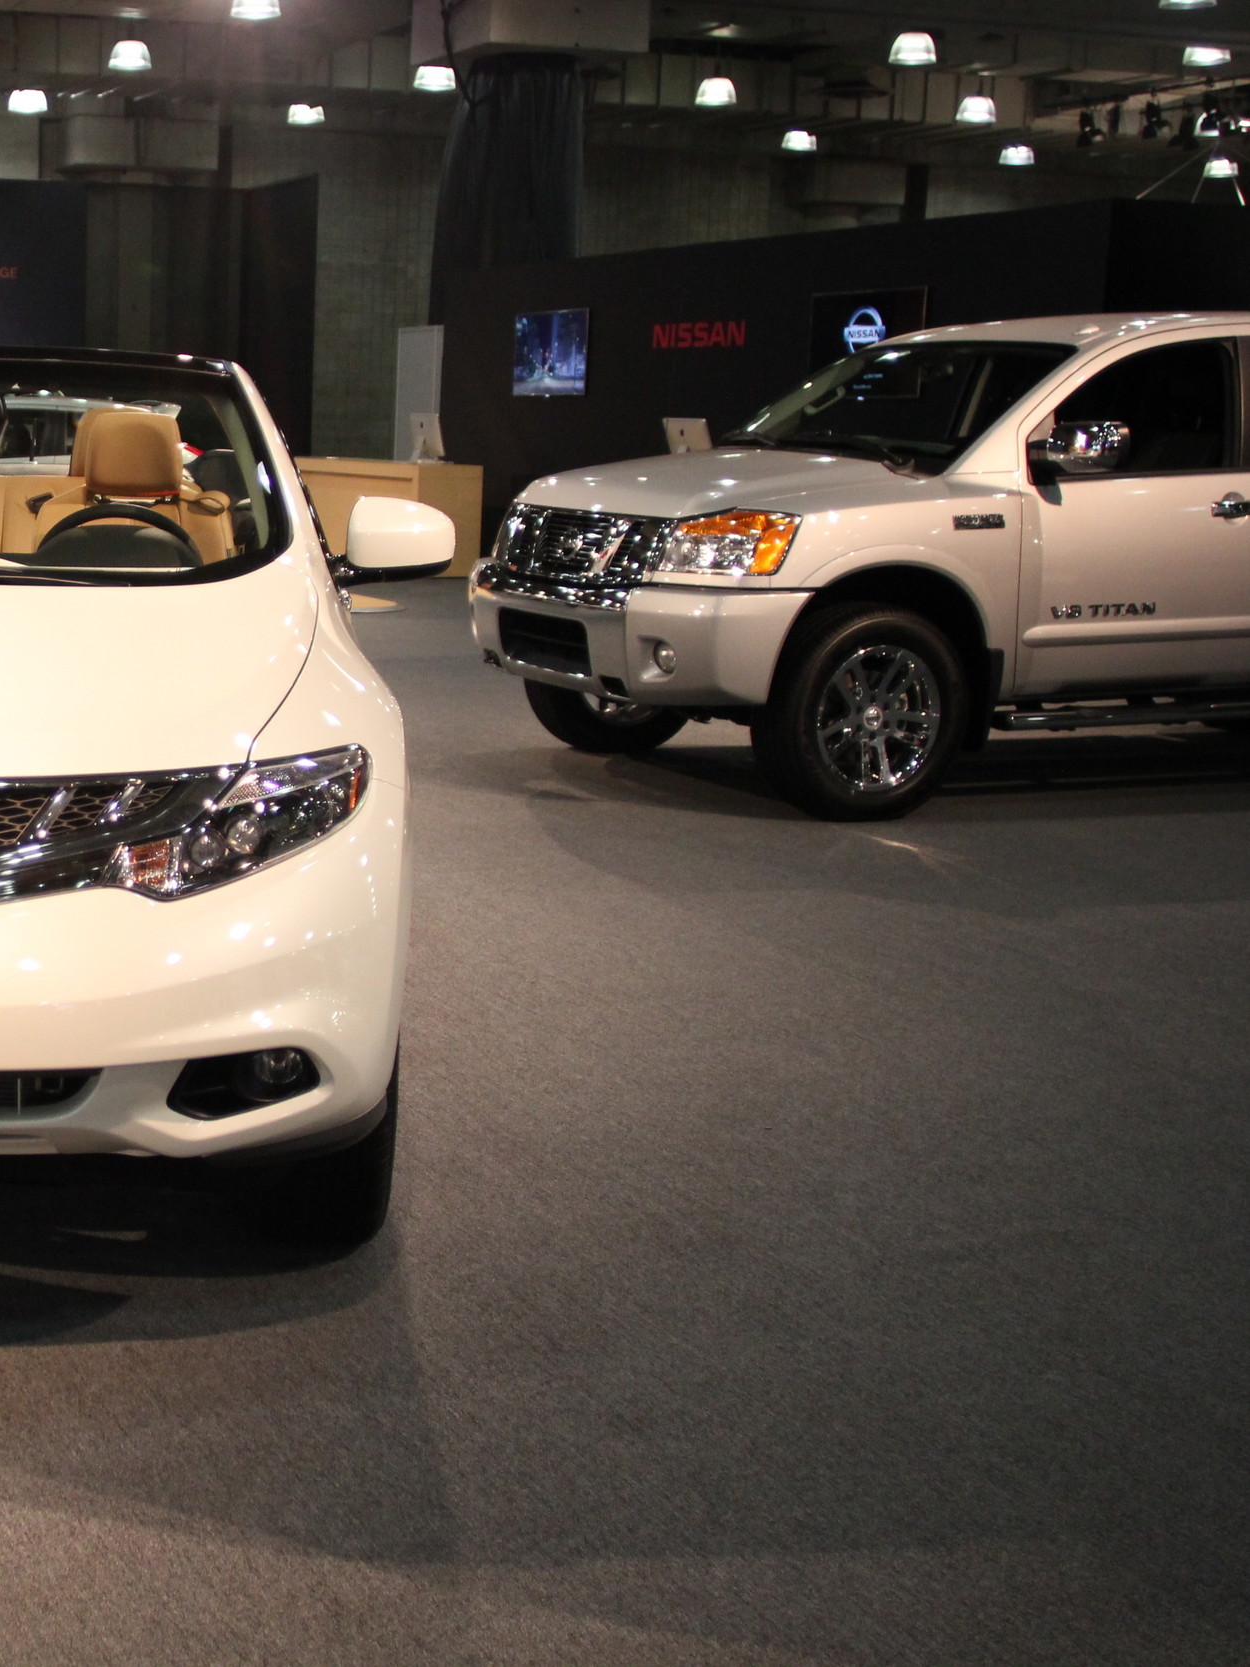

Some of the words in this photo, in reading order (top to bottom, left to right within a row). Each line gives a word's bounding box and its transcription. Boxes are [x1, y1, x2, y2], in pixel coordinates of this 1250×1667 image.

[652, 321, 746, 348] NISSAN
[848, 329, 881, 339] NISSAN
[1088, 602, 1156, 617] TITAN
